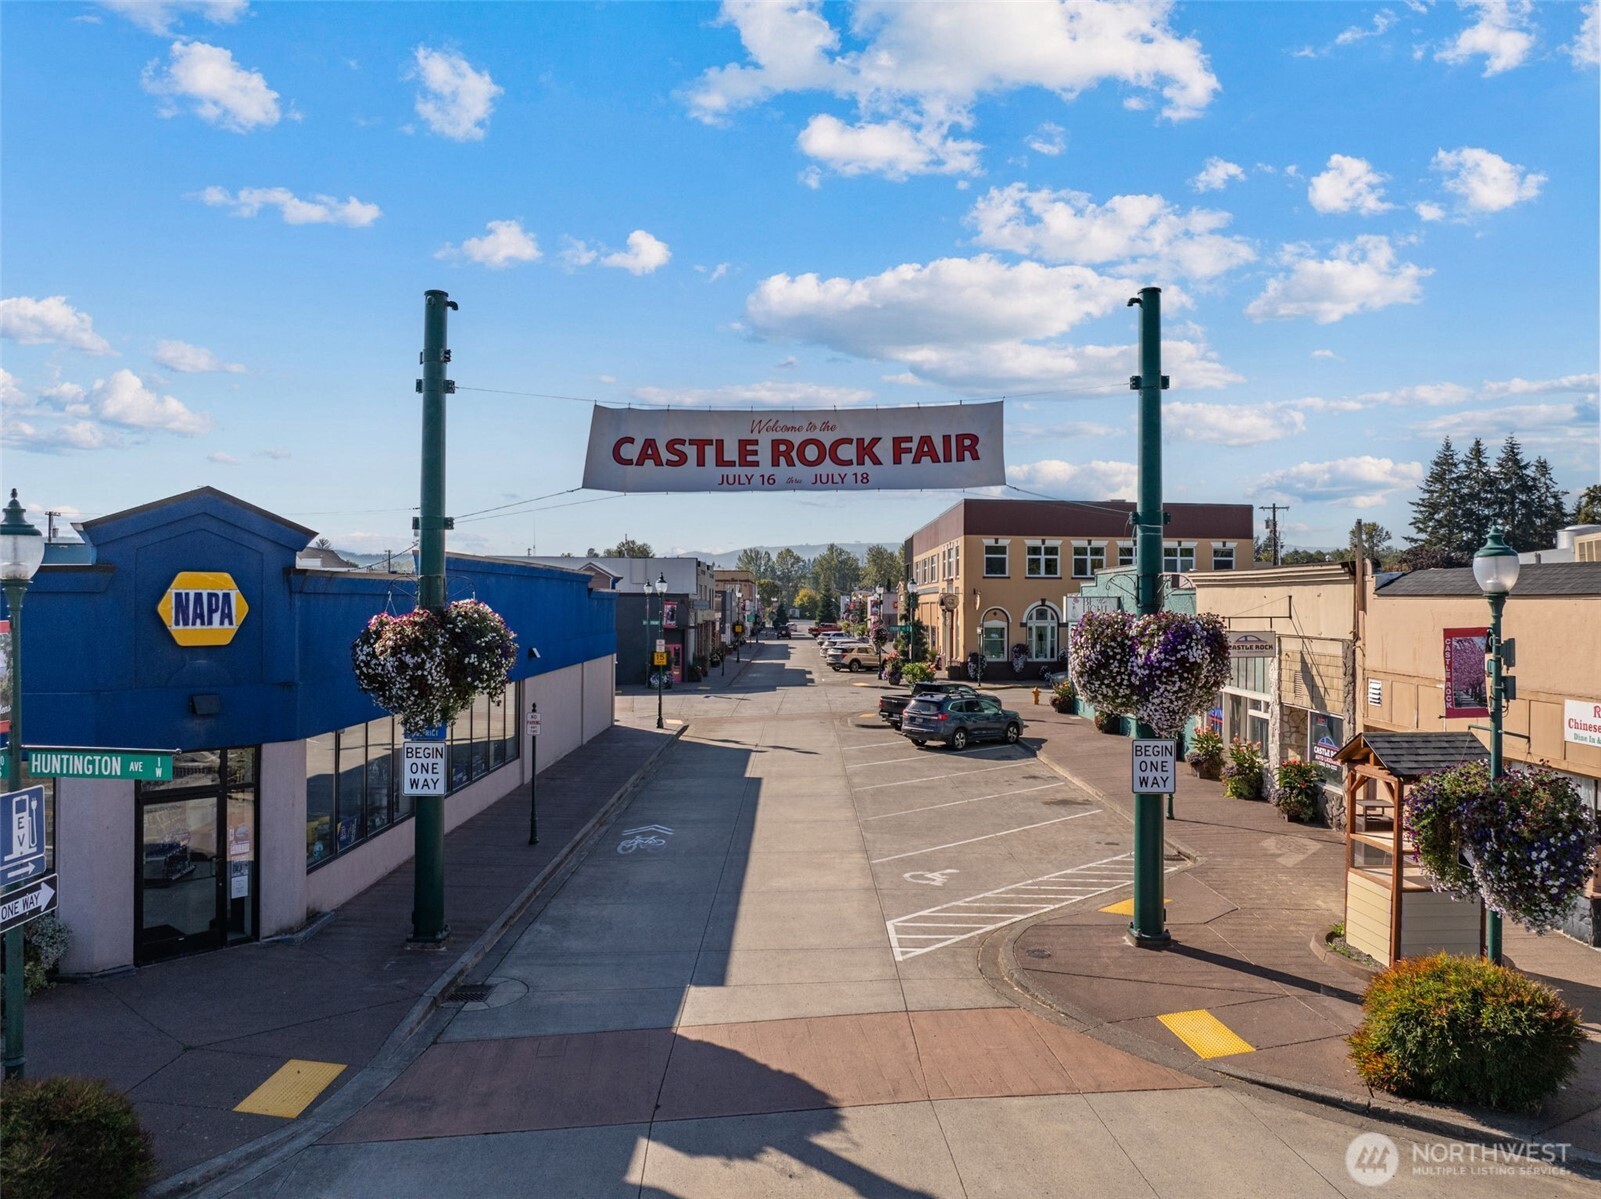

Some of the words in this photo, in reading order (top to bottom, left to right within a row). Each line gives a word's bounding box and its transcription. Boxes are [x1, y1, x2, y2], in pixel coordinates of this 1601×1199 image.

[750, 418, 804, 435] Welcome
[805, 421, 817, 432] to
[819, 420, 837, 432] the
[612, 436, 760, 468] CASTLE
[771, 437, 883, 467] ROCK
[892, 433, 981, 465] FAIR
[718, 474, 754, 486] JULY
[759, 474, 776, 486] 16
[811, 473, 848, 485] JULY
[852, 472, 870, 484] 18
[174, 591, 235, 627] NAPA
[1568, 718, 1601, 734] Chinese
[405, 747, 444, 759] BEGIN
[1135, 745, 1173, 757] BEGIN
[1313, 745, 1331, 758] CASTLE
[31, 754, 121, 776] HUNTINGTON
[129, 761, 143, 772] AVE
[410, 762, 440, 775] ONE
[1139, 760, 1169, 773] ONE
[155, 767, 162, 778] W
[409, 777, 440, 790] WAY
[1139, 776, 1169, 788] WAY
[1, 902, 20, 920] ONE
[22, 892, 40, 911] WAY
